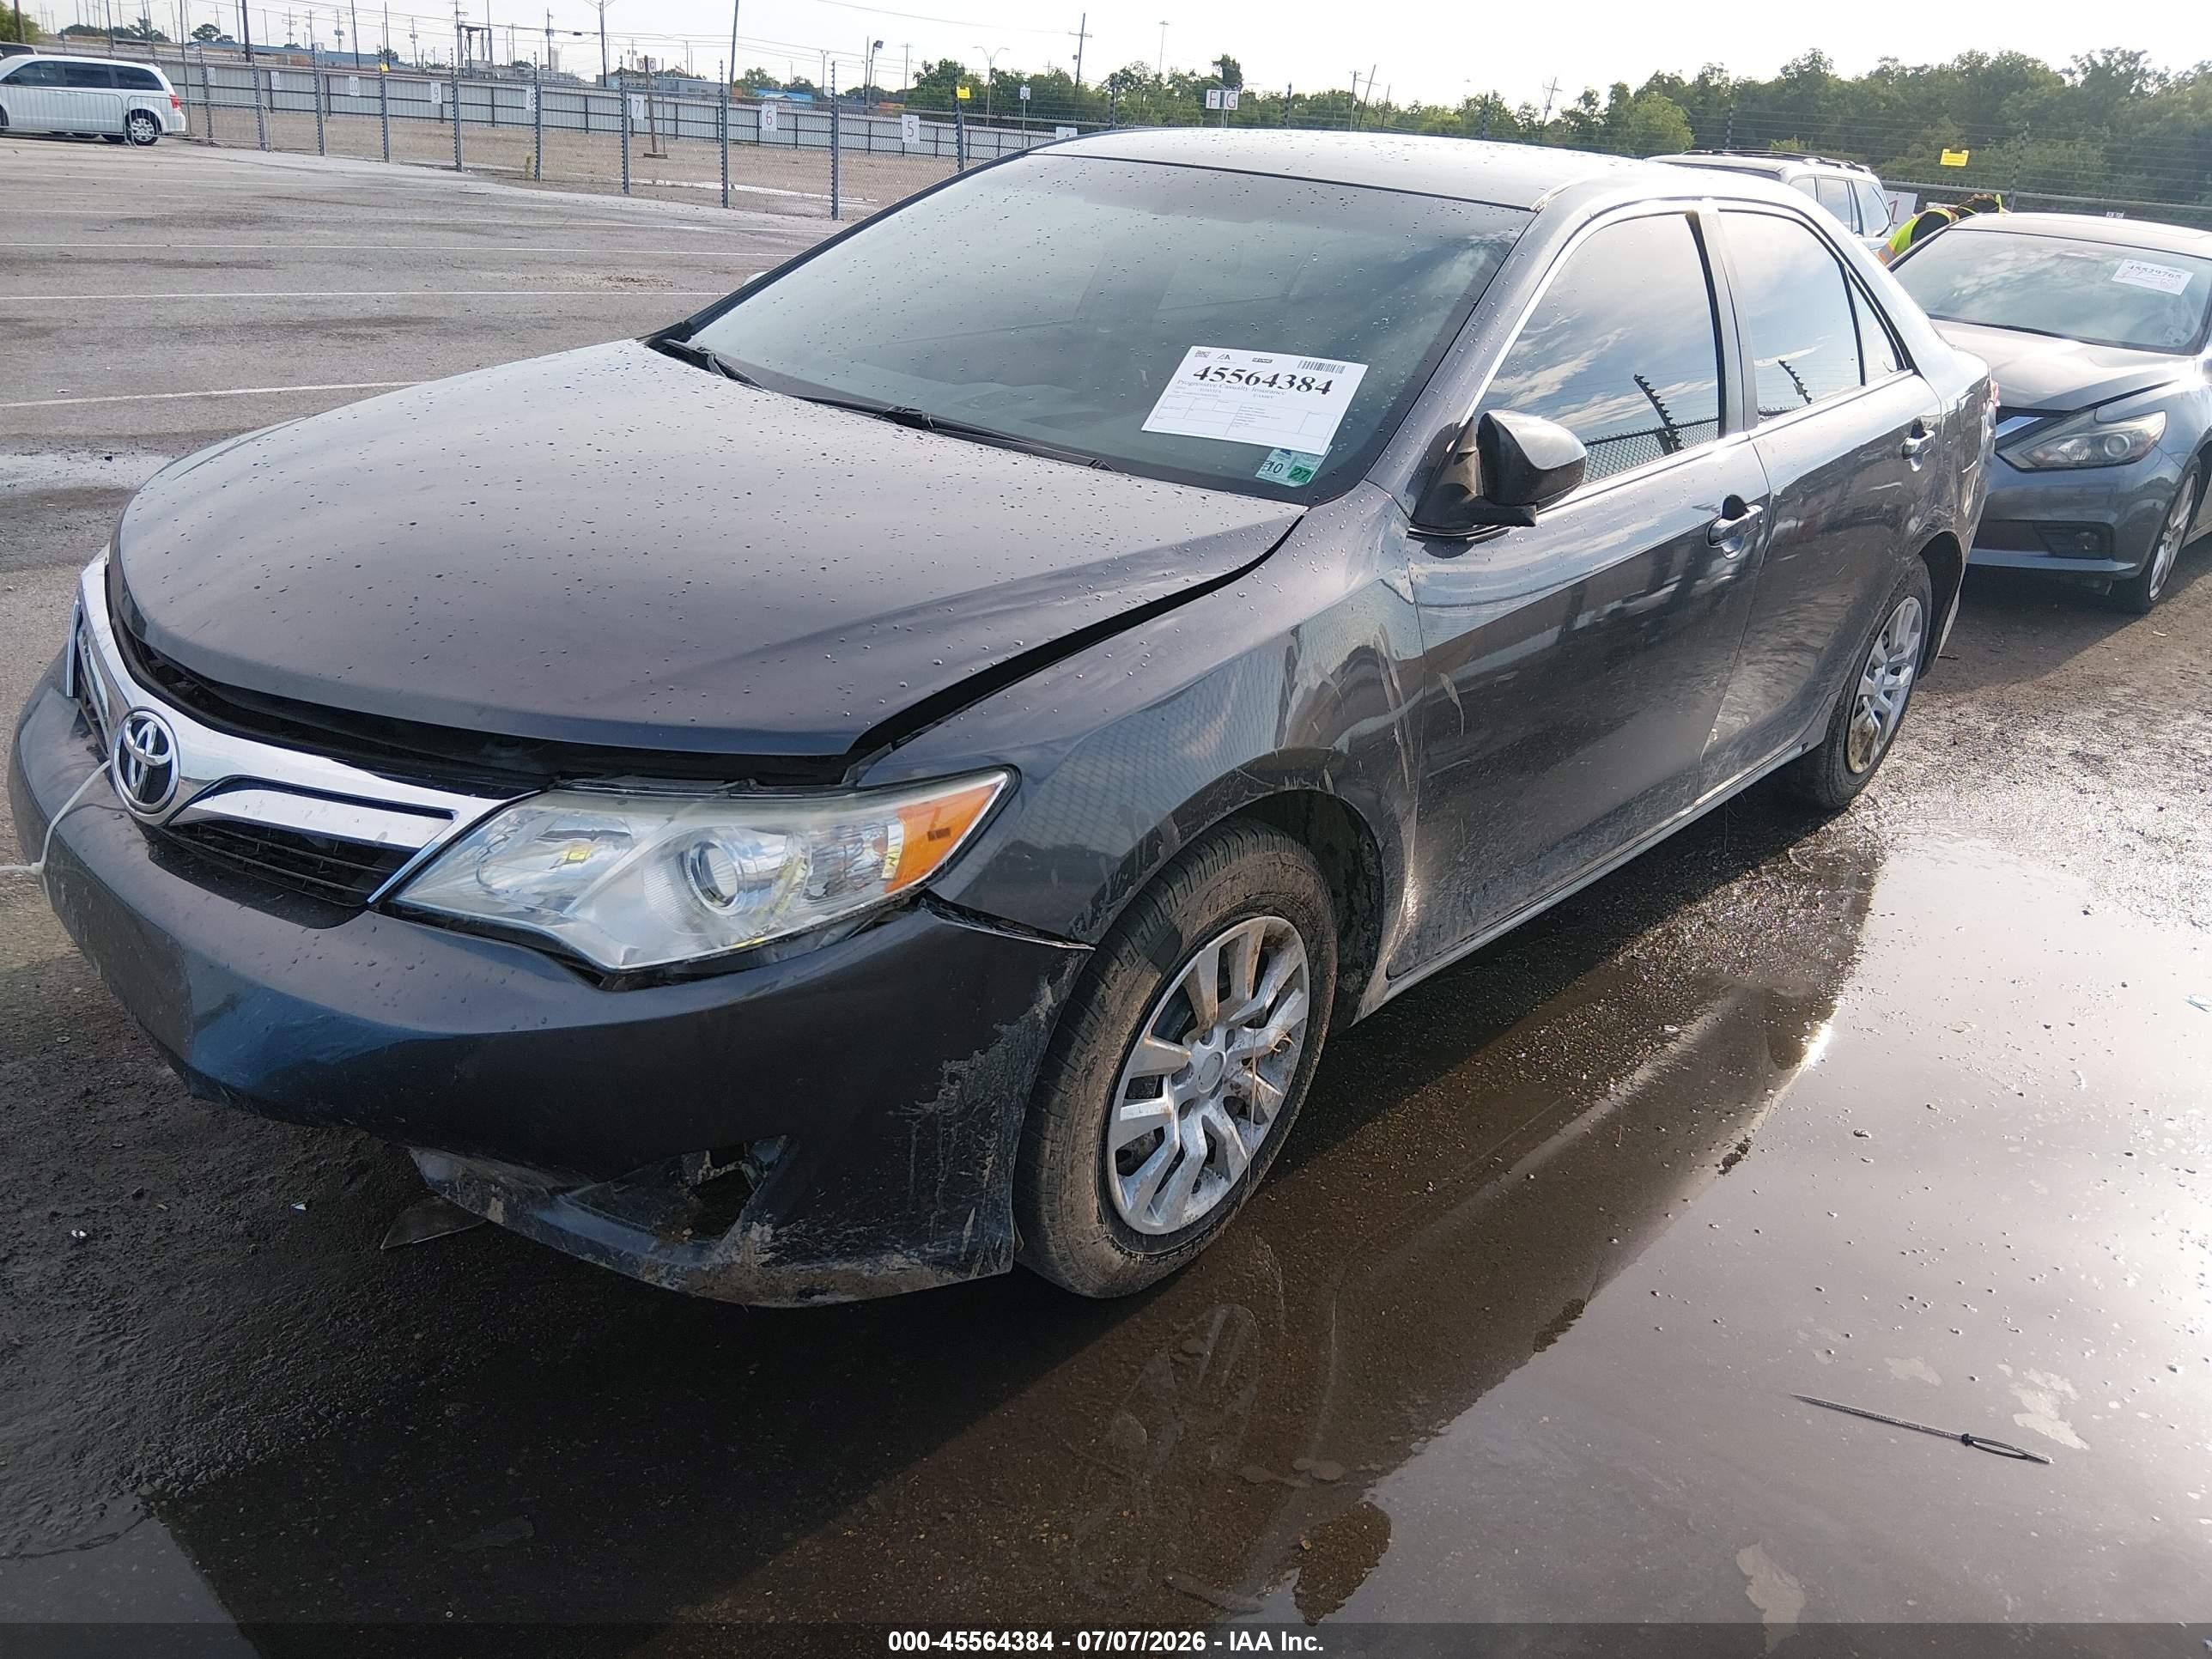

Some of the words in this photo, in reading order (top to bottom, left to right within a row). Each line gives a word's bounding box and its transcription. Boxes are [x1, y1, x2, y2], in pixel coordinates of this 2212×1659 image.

[350, 80, 359, 93] 10
[529, 93, 535, 106] 8
[1209, 91, 1217, 107] F
[1226, 92, 1237, 108] G
[766, 110, 773, 125] 6
[907, 121, 915, 137] 5
[1193, 366, 1333, 395] 45564384
[1267, 460, 1284, 474] 10
[1291, 468, 1311, 481] 27
